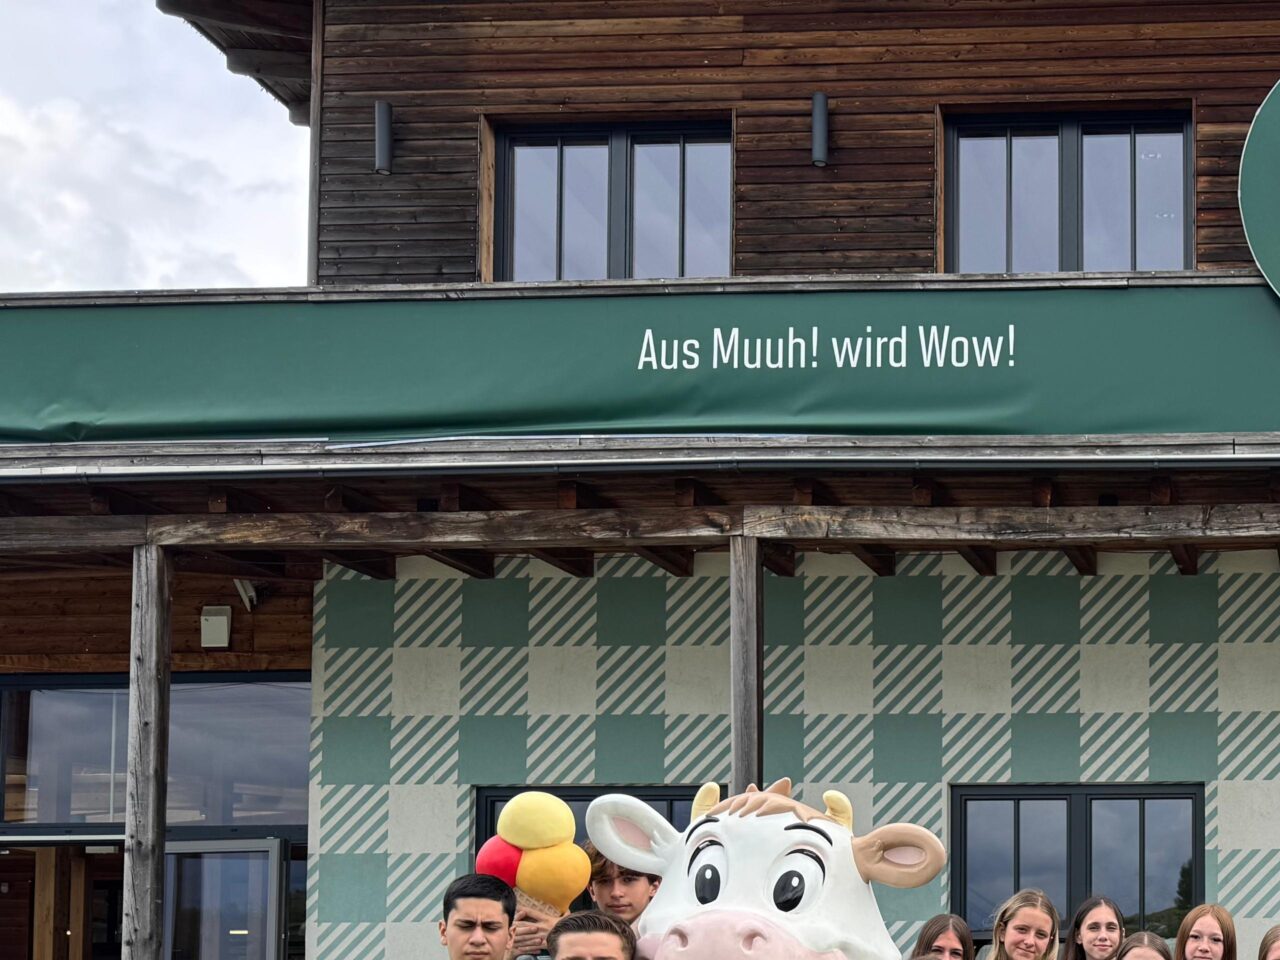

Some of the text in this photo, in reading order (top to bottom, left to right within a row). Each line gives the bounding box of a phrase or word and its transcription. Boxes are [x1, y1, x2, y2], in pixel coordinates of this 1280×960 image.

[638, 324, 1016, 370] Aus Muuh! wird Wow!
